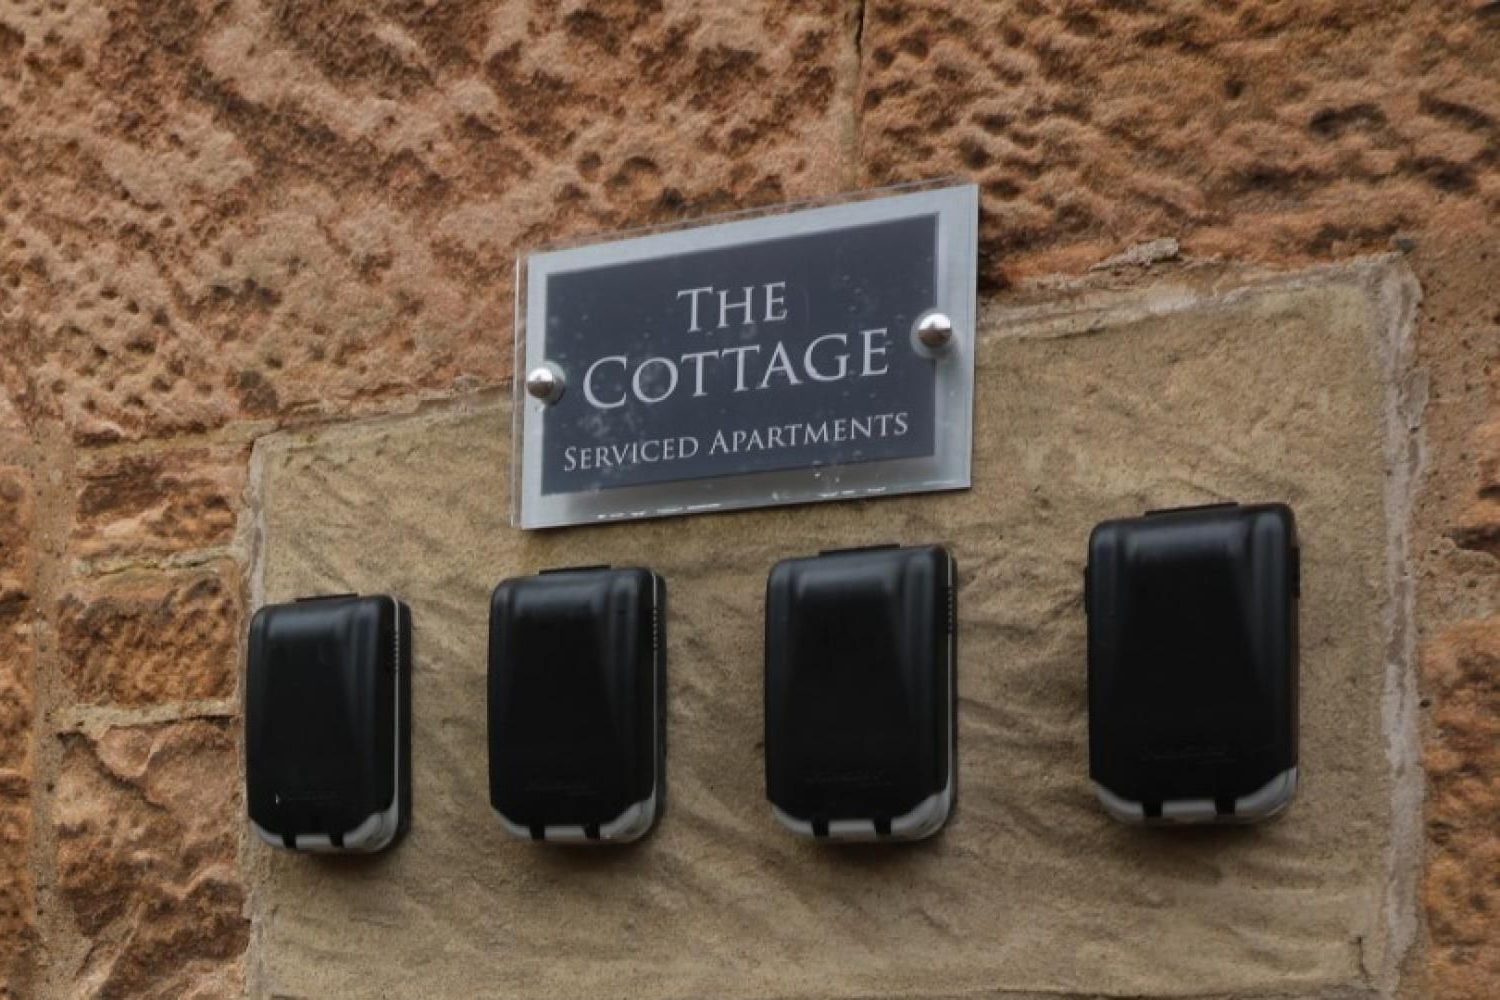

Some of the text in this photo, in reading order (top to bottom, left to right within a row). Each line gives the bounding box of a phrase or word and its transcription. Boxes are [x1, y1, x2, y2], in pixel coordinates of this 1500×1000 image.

[677, 281, 788, 333] THE
[583, 327, 890, 410] COTTAGE
[563, 412, 909, 472] SERVICED APARTMENTS
